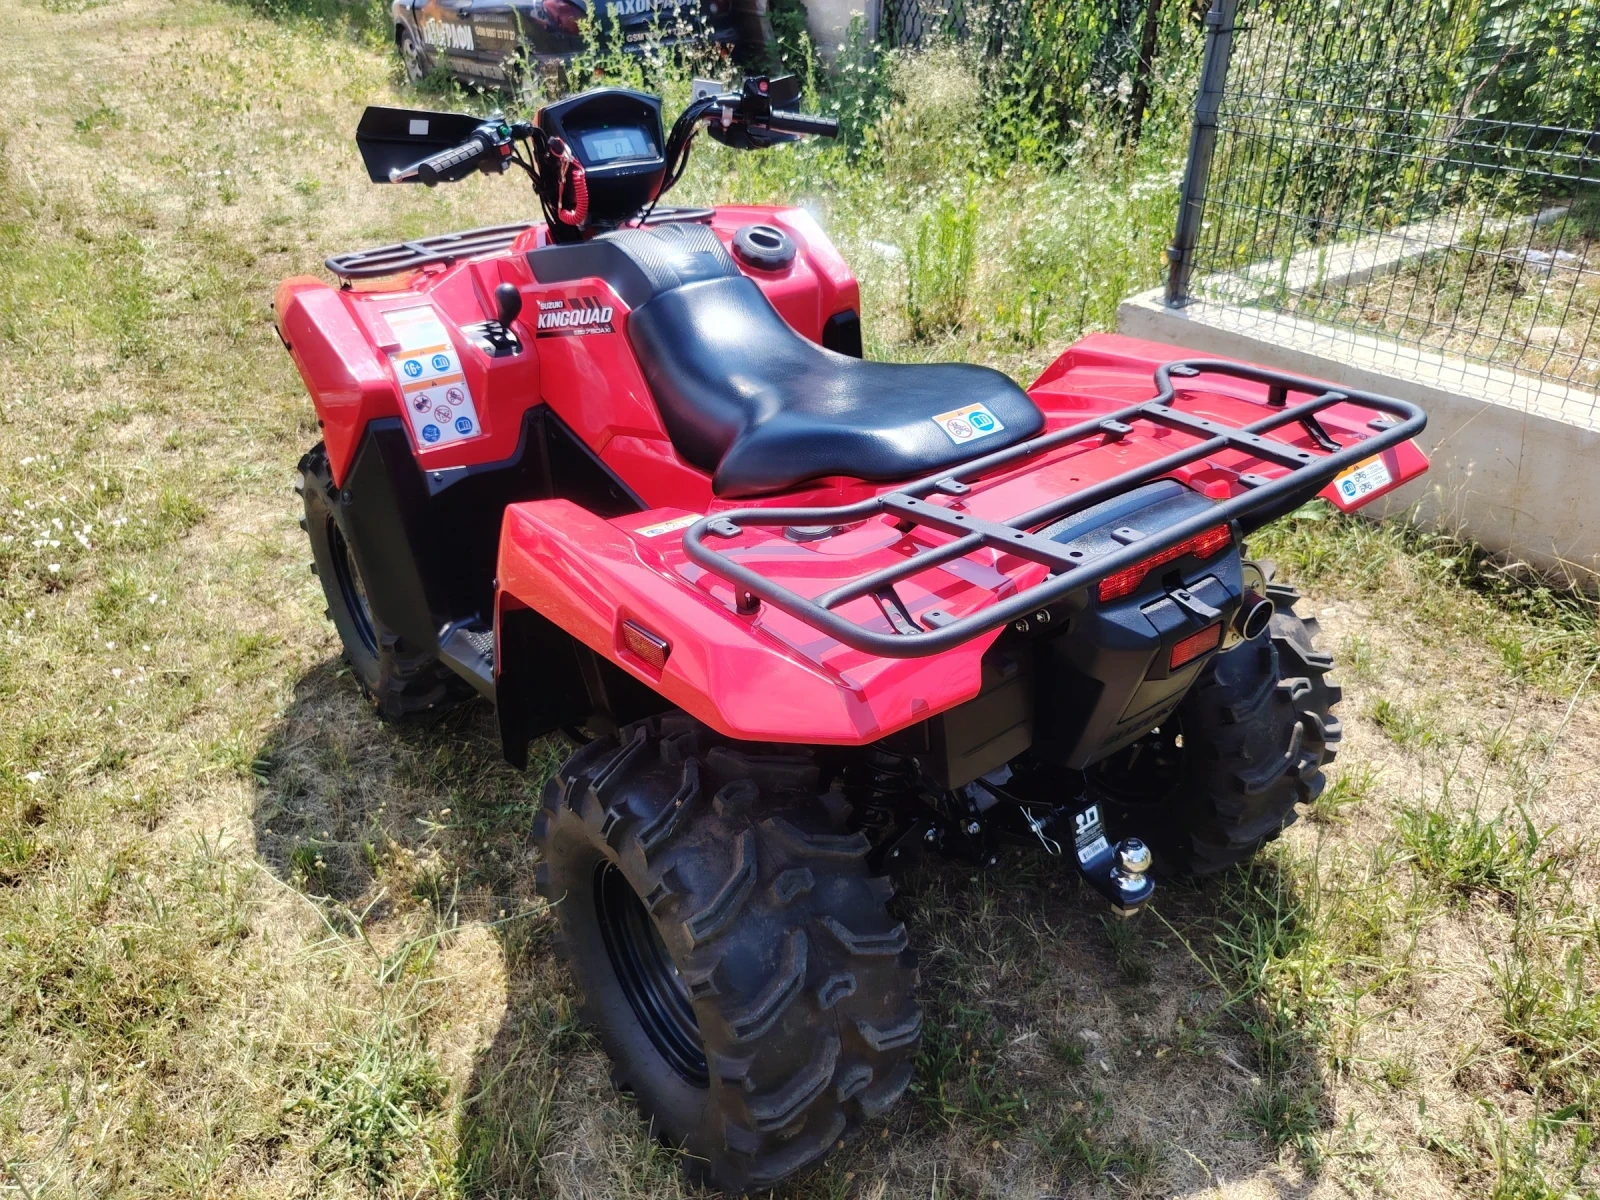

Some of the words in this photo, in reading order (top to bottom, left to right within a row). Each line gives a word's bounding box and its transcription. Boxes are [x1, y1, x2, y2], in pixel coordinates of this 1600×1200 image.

[540, 300, 564, 311] SUZUKI
[537, 306, 614, 330] KINGQUAD
[404, 360, 422, 376] 16+
